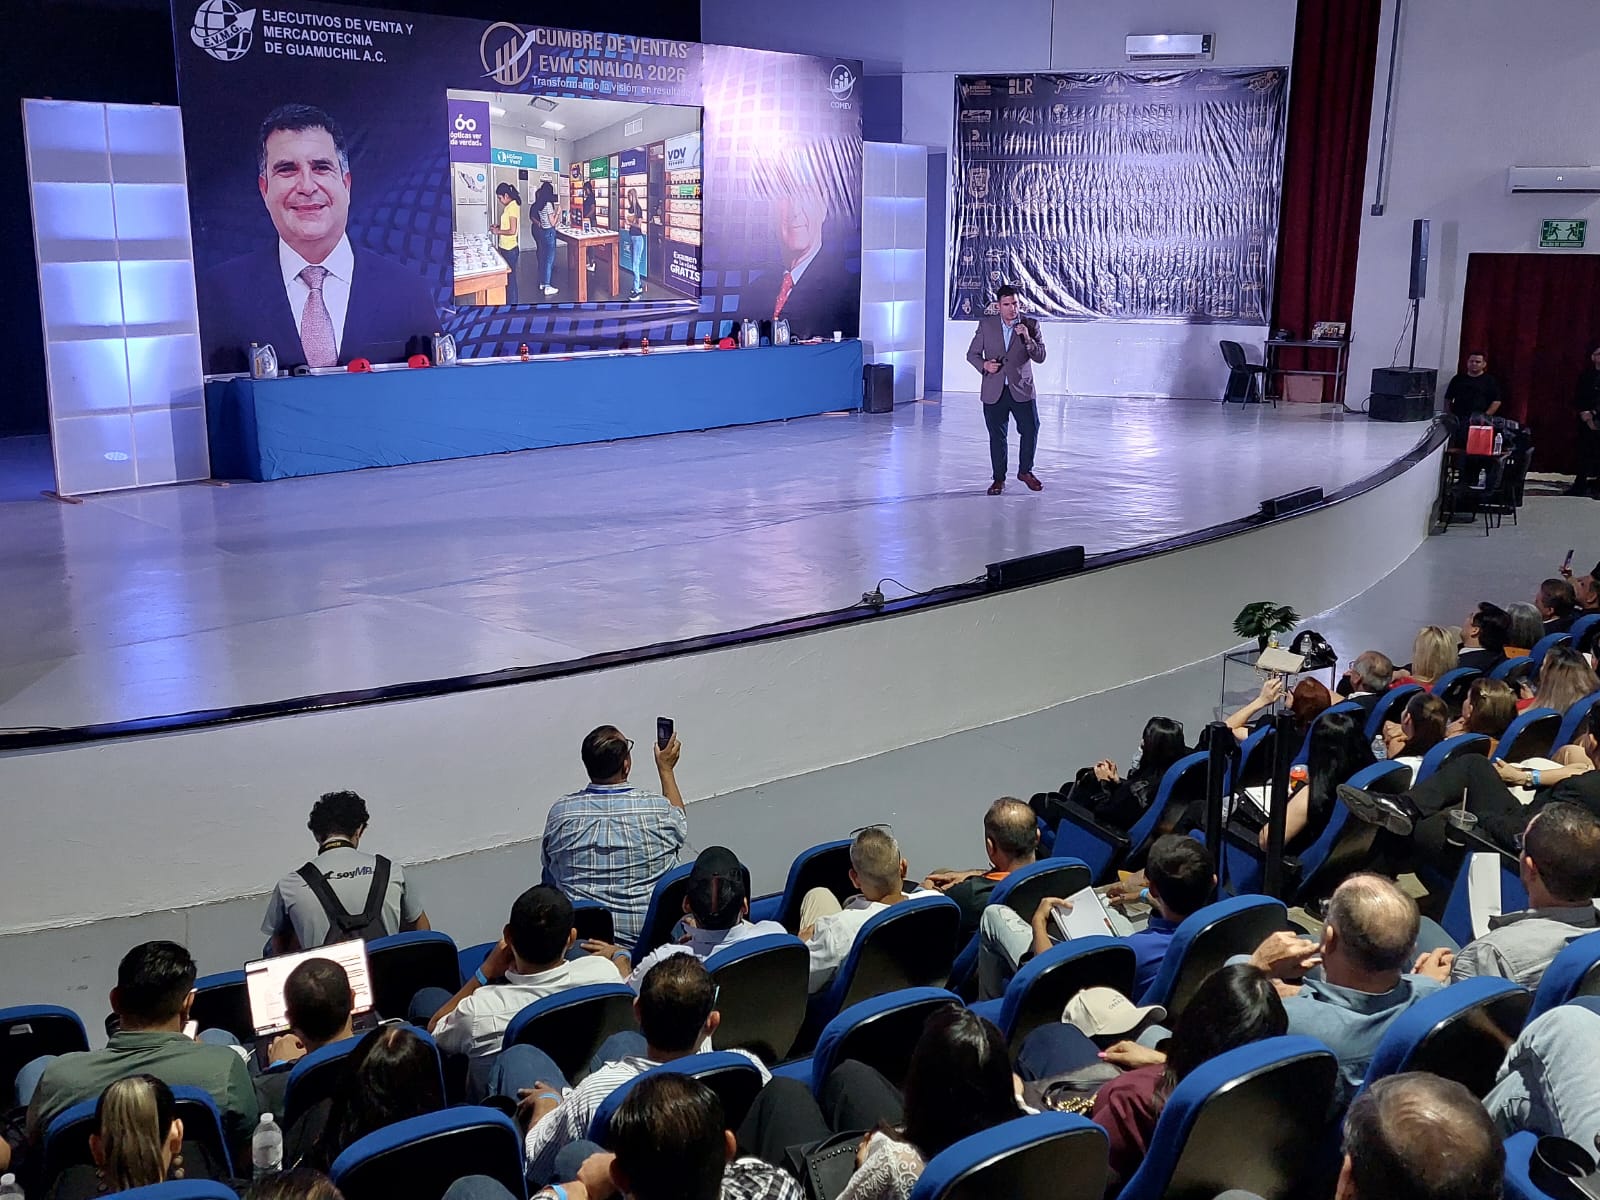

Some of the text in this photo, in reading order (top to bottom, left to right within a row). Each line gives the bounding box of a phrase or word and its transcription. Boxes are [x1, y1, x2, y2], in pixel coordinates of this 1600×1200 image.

[262, 9, 414, 36] EJECUTIVOS DE VENTA Y
[203, 24, 242, 47] E.V.M.G.
[263, 25, 373, 47] MERCADOTECNIA
[535, 28, 688, 59] CUMBRE DE VENTAS
[265, 41, 387, 63] DE GUAMUCHIL A.C.
[539, 54, 687, 83] EVM SINALOA 2026
[531, 75, 600, 91] Transformando
[611, 82, 637, 94] visión
[641, 85, 652, 95] en
[668, 147, 687, 161] VDV
[673, 250, 698, 265] Examen
[670, 263, 701, 282] GRATIS
